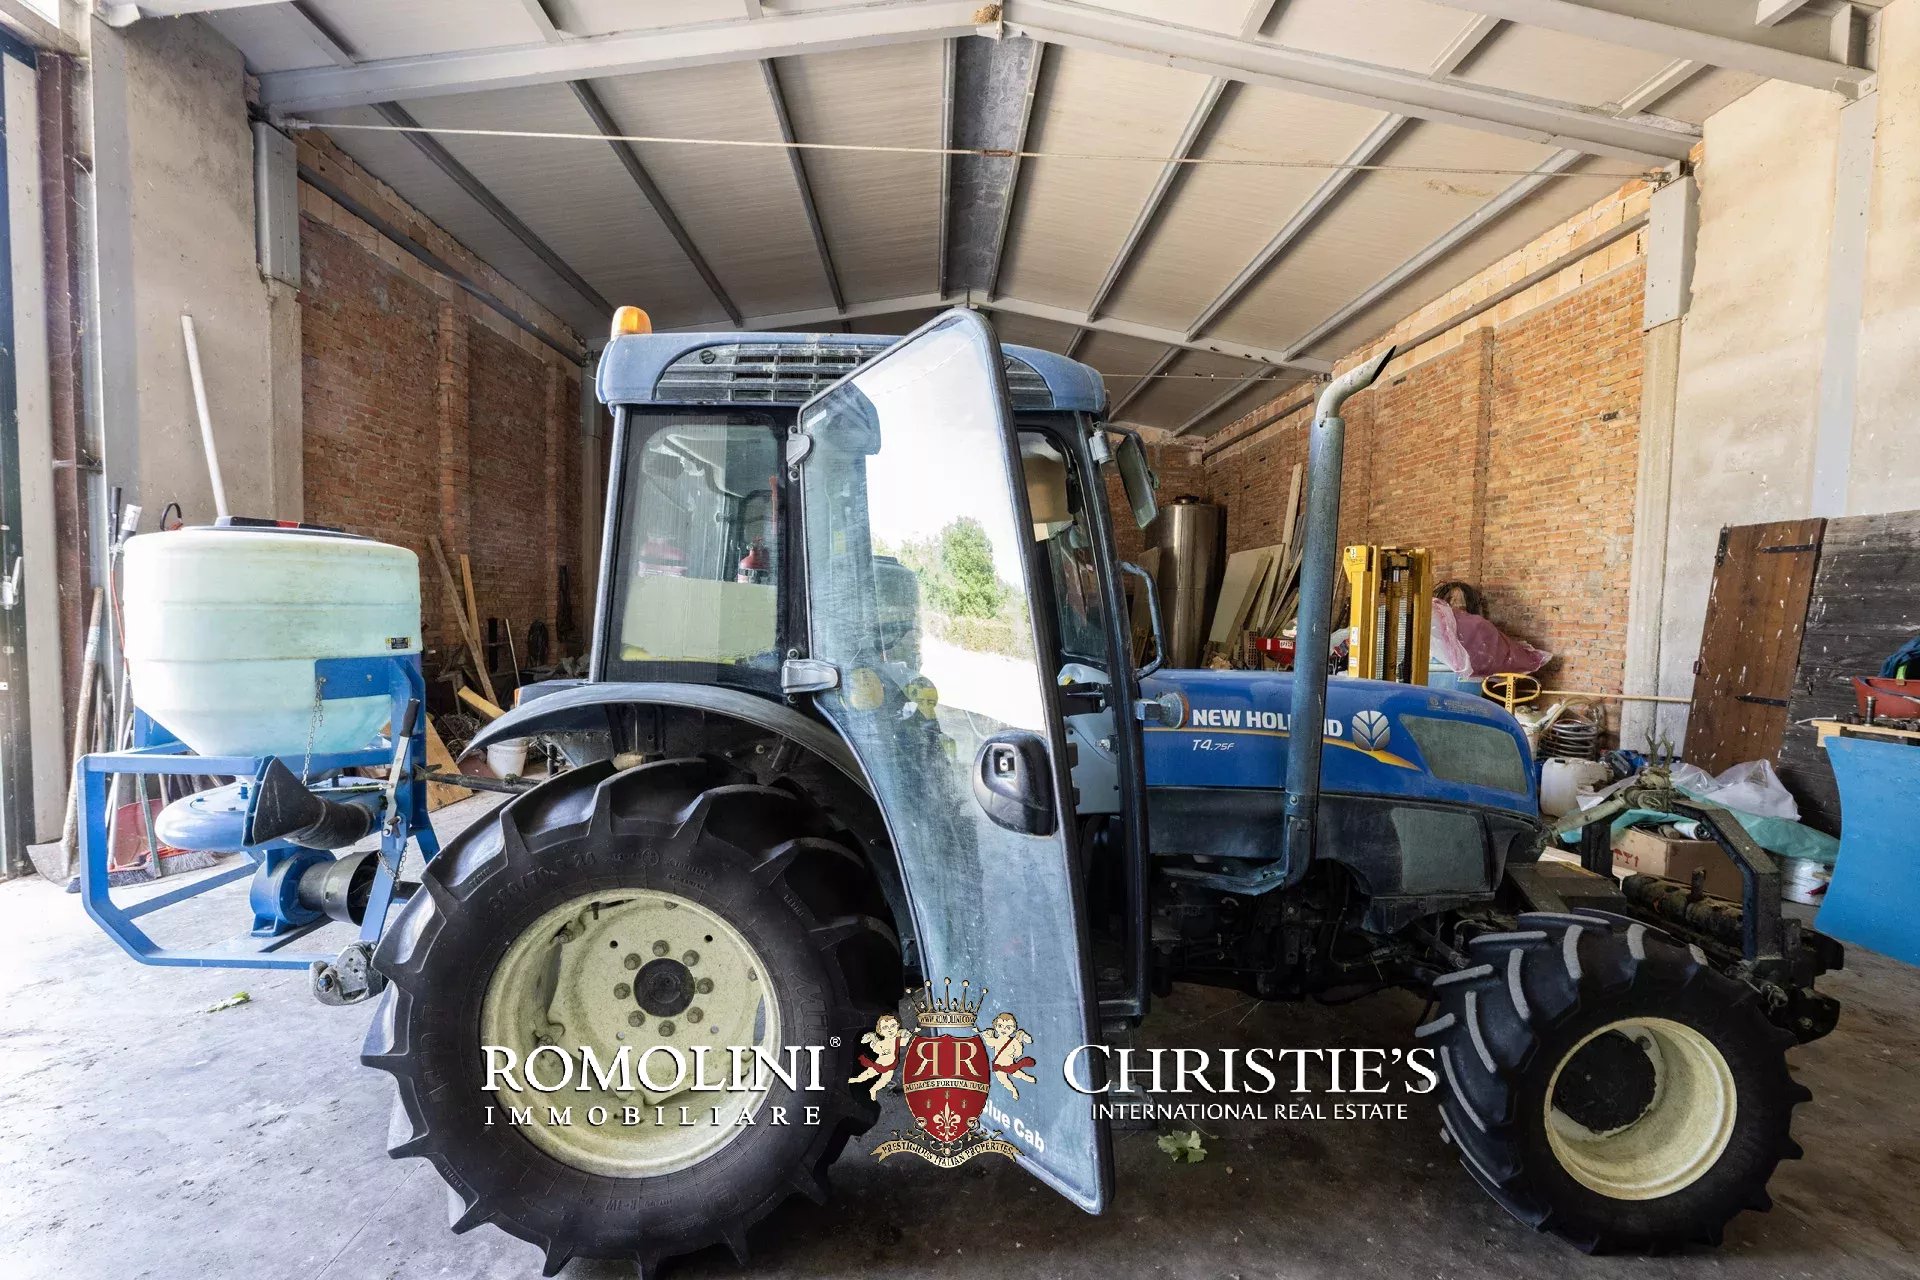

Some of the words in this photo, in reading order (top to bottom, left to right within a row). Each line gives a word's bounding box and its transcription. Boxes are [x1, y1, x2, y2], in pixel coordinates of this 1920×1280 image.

[1193, 709, 1241, 728] NEW
[1246, 711, 1343, 738] HOLD
[1013, 1117, 1045, 1153] Cab
